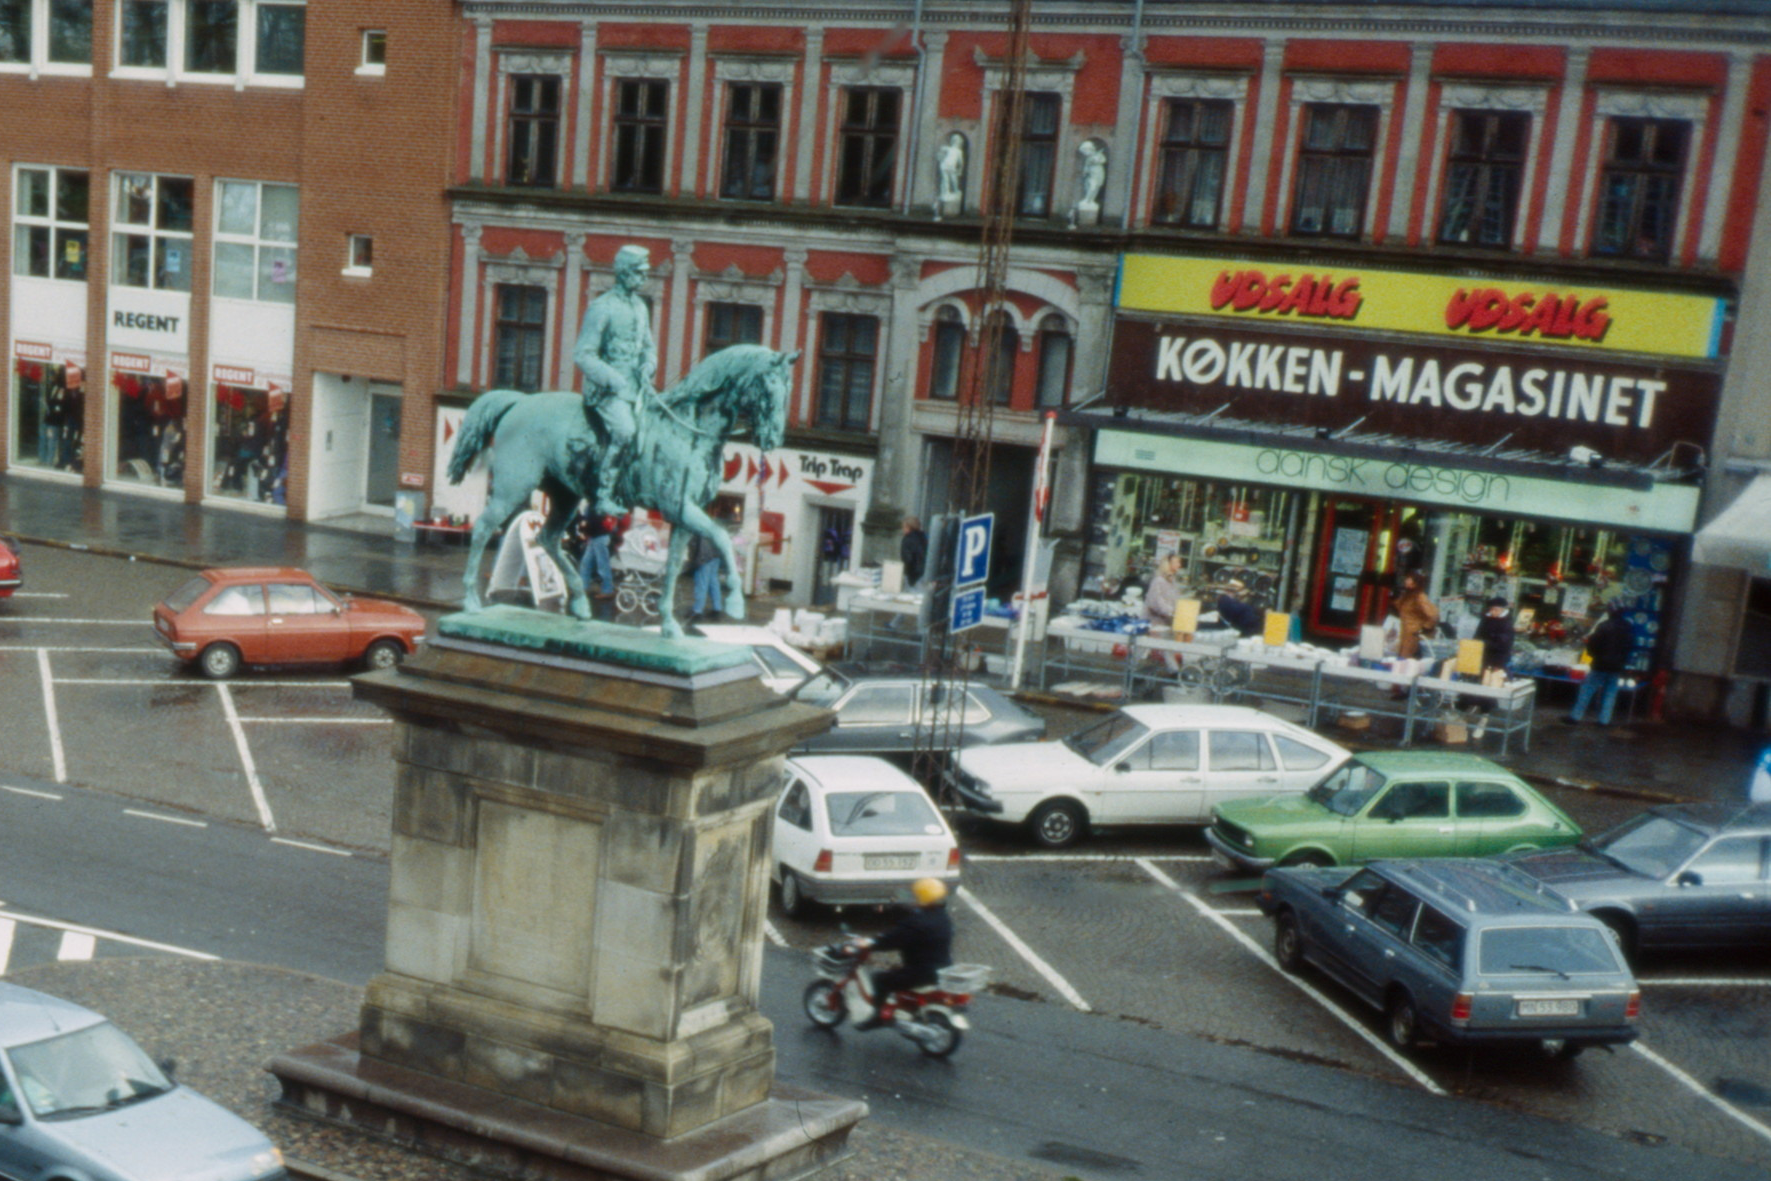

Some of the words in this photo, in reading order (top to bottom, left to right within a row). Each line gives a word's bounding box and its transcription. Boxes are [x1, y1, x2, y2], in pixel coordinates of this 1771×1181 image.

[1209, 270, 1364, 320] UDSALG
[1445, 287, 1610, 341] UDSALG
[114, 310, 180, 333] REGENT
[799, 455, 827, 478] Trip
[830, 459, 863, 482] Trap
[1256, 448, 1371, 489] dansk
[1383, 462, 1511, 504] design
[961, 525, 986, 577] P
